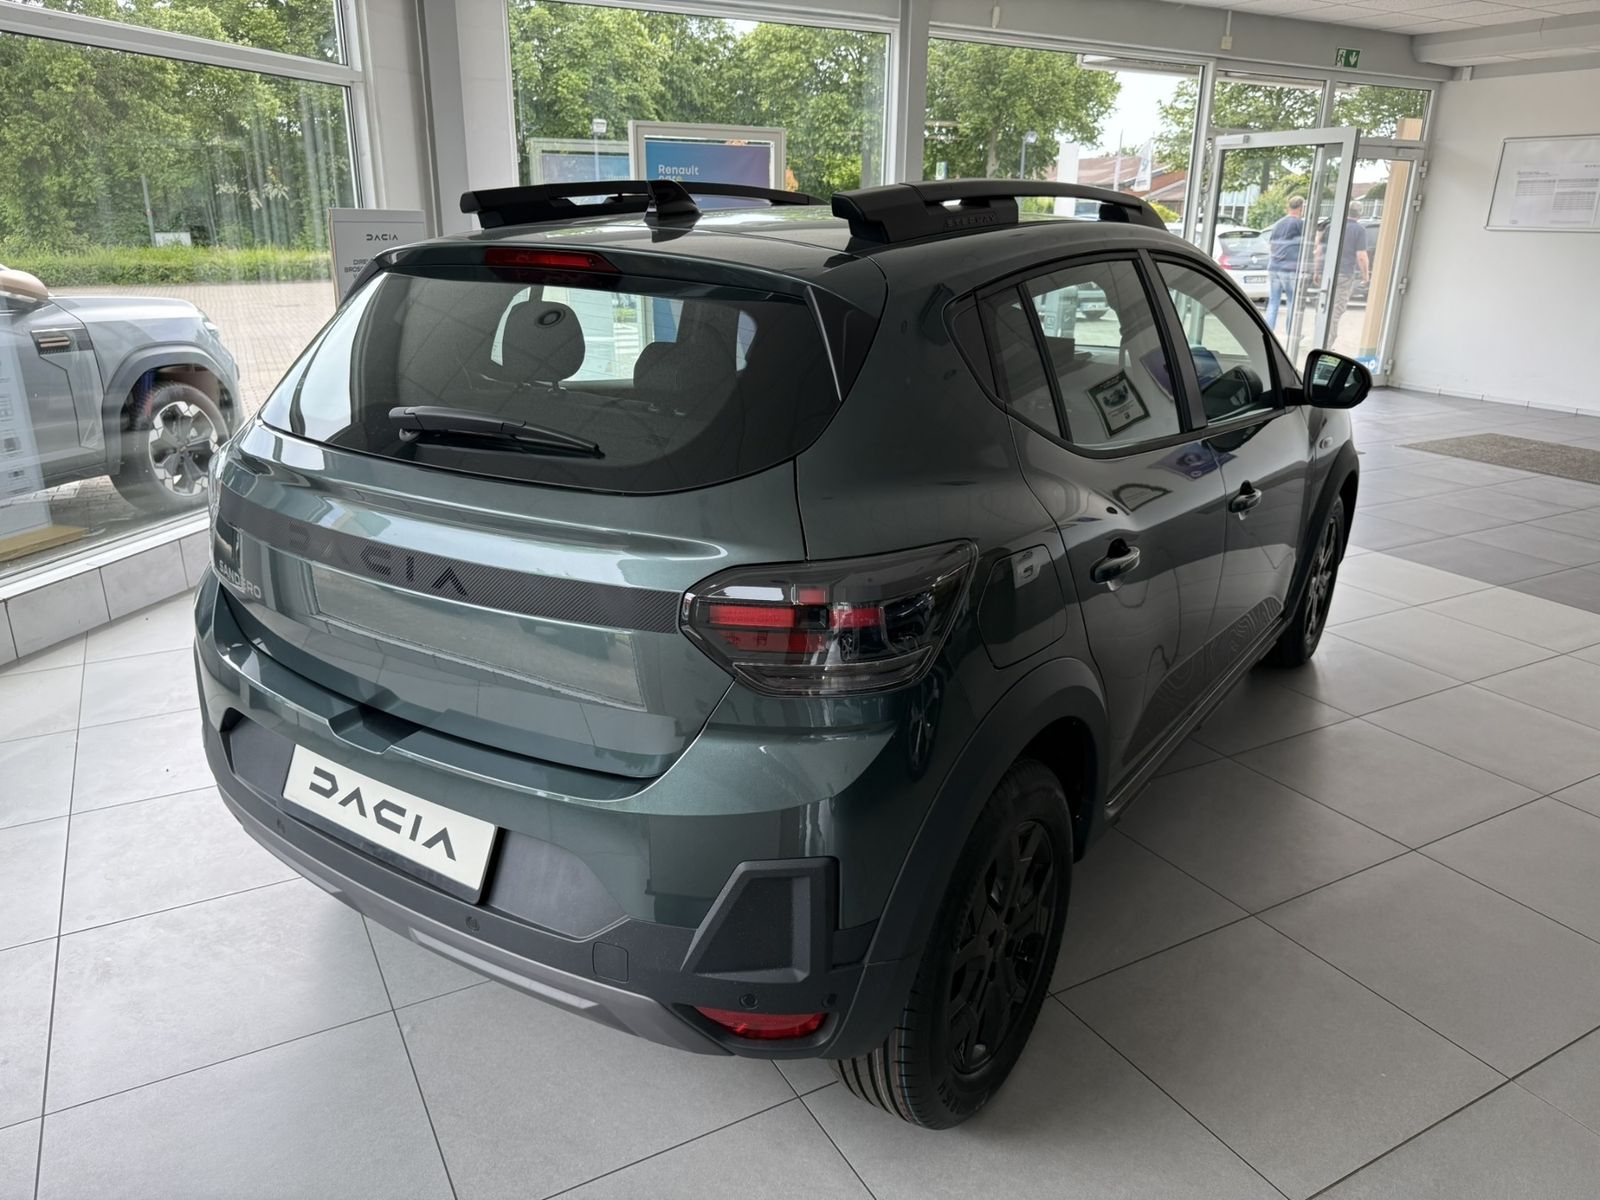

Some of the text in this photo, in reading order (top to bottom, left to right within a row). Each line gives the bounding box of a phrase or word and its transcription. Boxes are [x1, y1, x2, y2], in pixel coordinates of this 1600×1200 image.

[658, 164, 699, 176] Renault
[366, 233, 398, 241] DACIA
[289, 519, 468, 598] DACIA
[218, 559, 262, 599] SANDERO
[309, 766, 457, 862] DACIA
